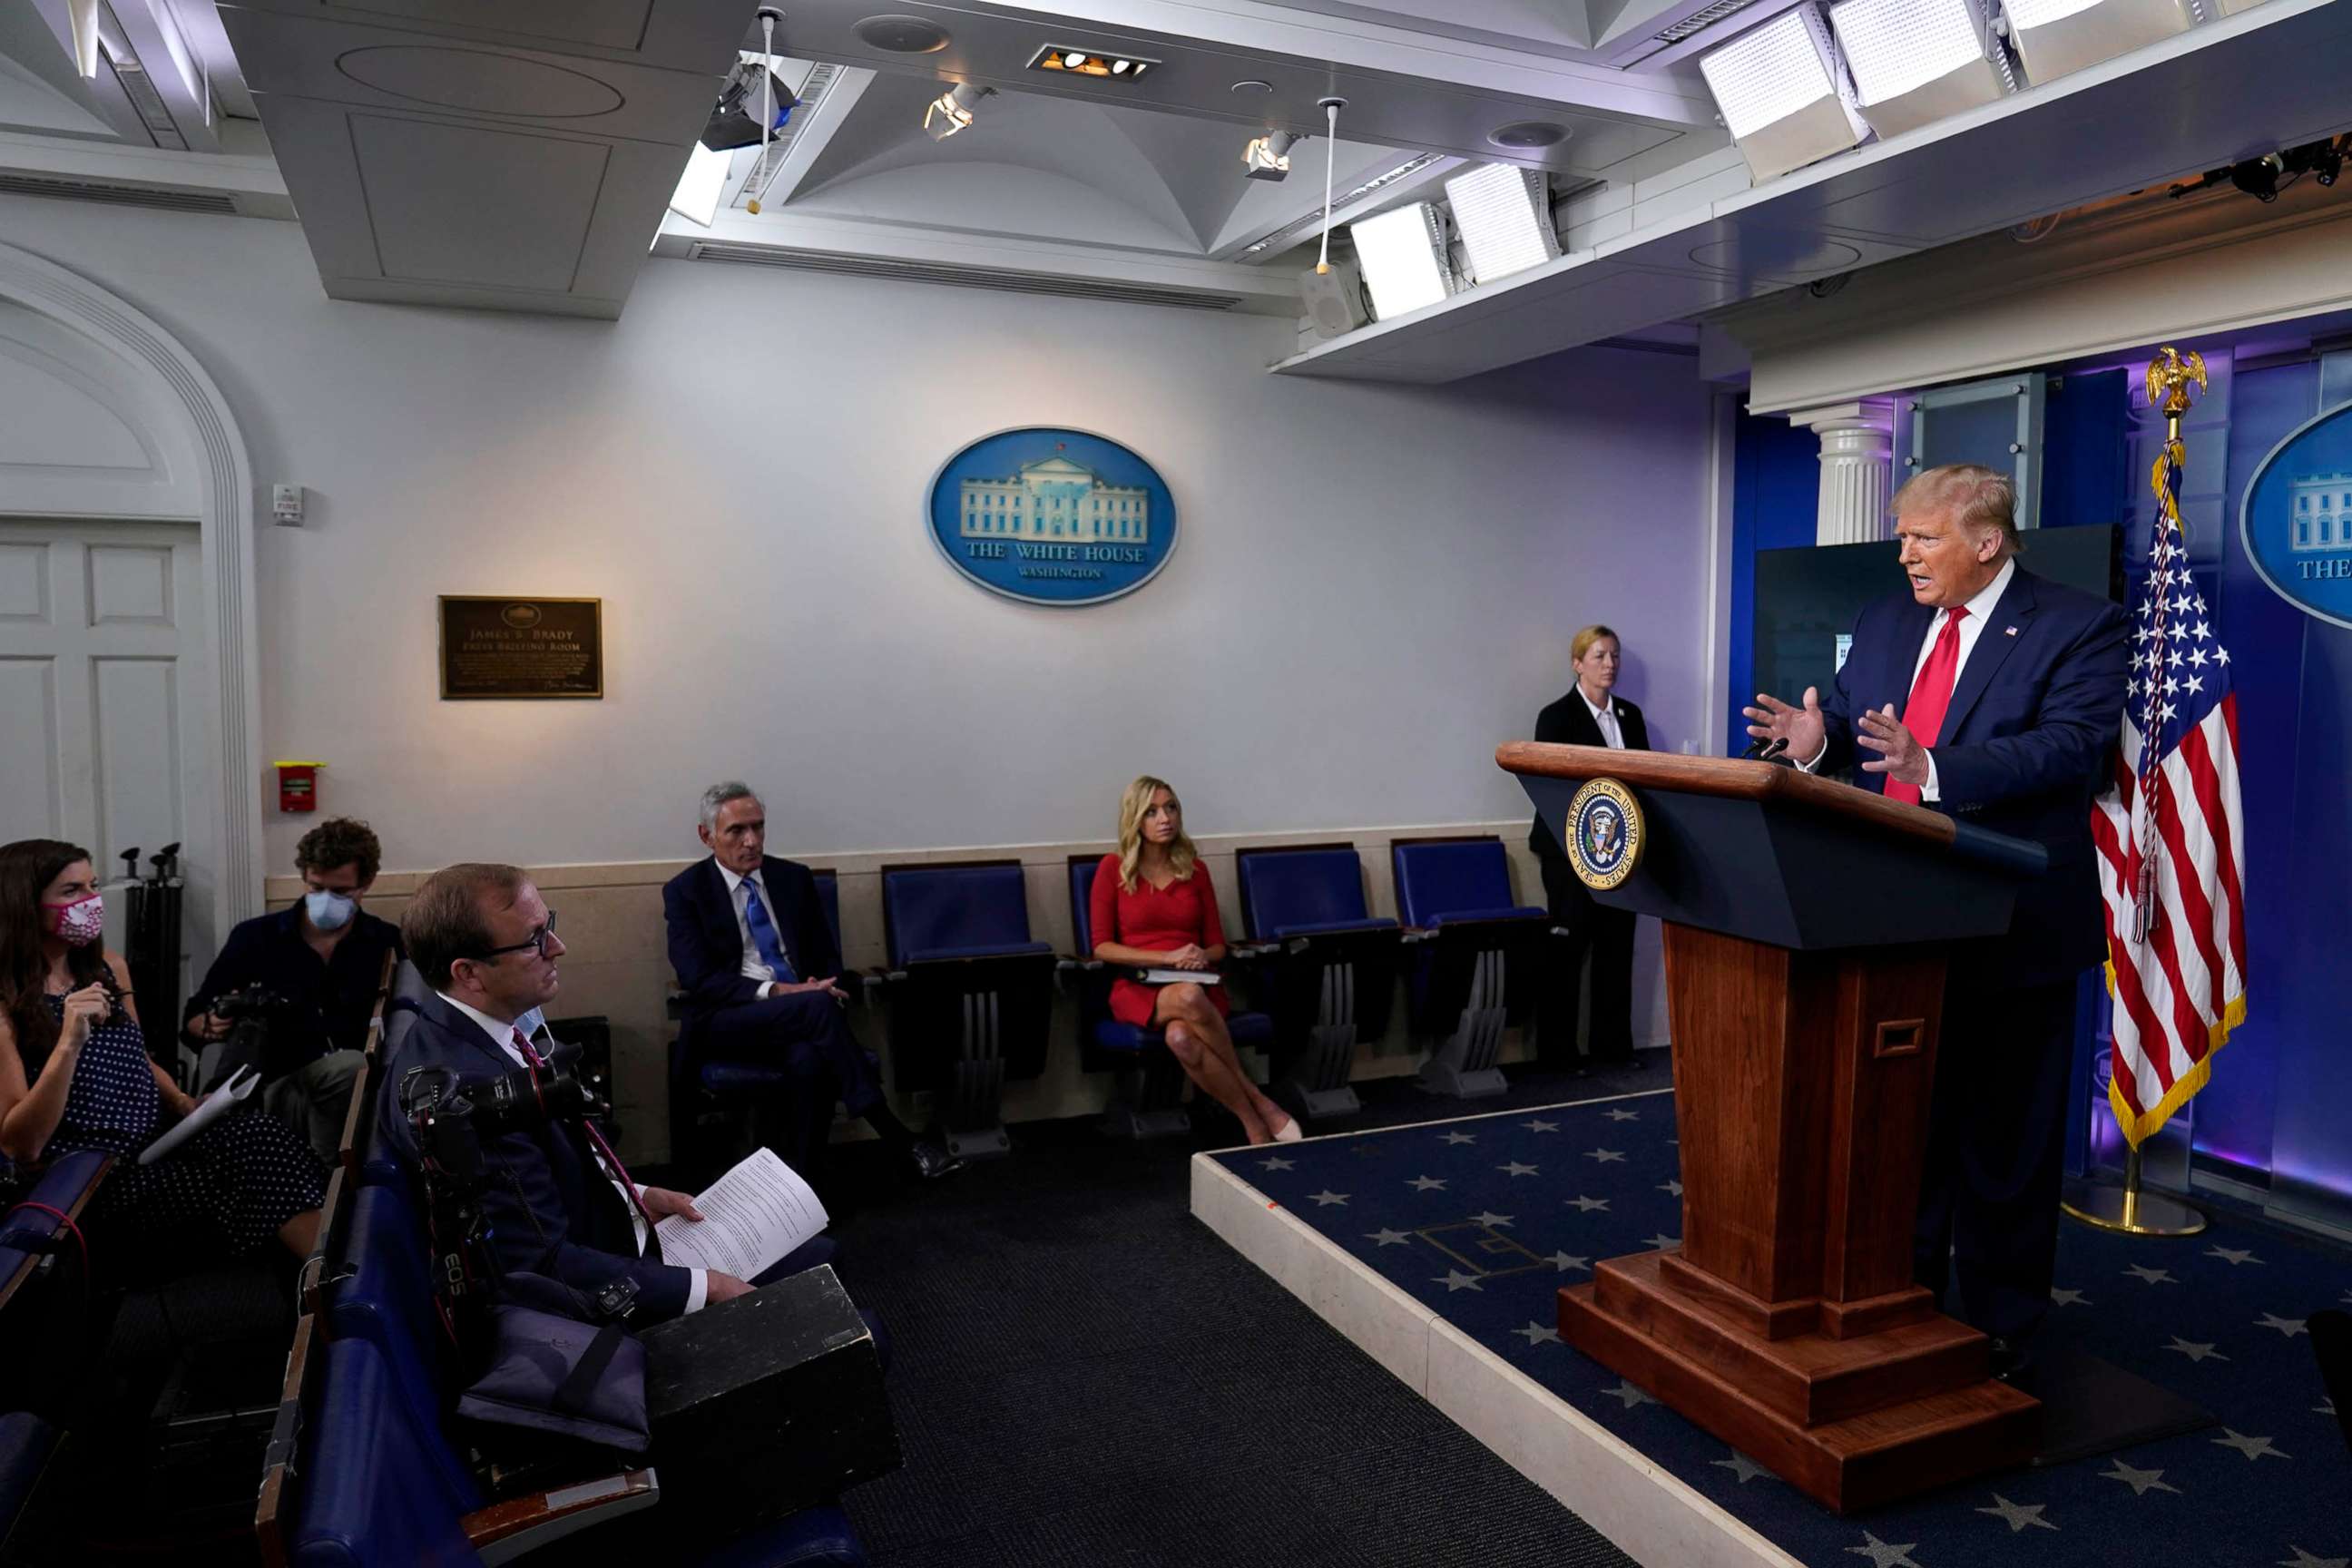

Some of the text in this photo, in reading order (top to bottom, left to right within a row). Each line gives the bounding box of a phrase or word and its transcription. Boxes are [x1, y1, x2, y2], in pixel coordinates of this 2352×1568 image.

[967, 543, 1144, 563] THE WHITE HOUSE
[1017, 566, 1102, 579] WASHINGTON
[2297, 559, 2352, 579] THE
[470, 629, 510, 641] JAMES
[533, 630, 574, 641] BRADY
[550, 642, 581, 652] ROOM
[1569, 782, 1602, 828] PRESIDENT
[1622, 799, 1637, 844] UNITED
[1576, 861, 1594, 883] SEAL
[1605, 855, 1632, 886] STATES
[445, 1253, 467, 1296] EOS
